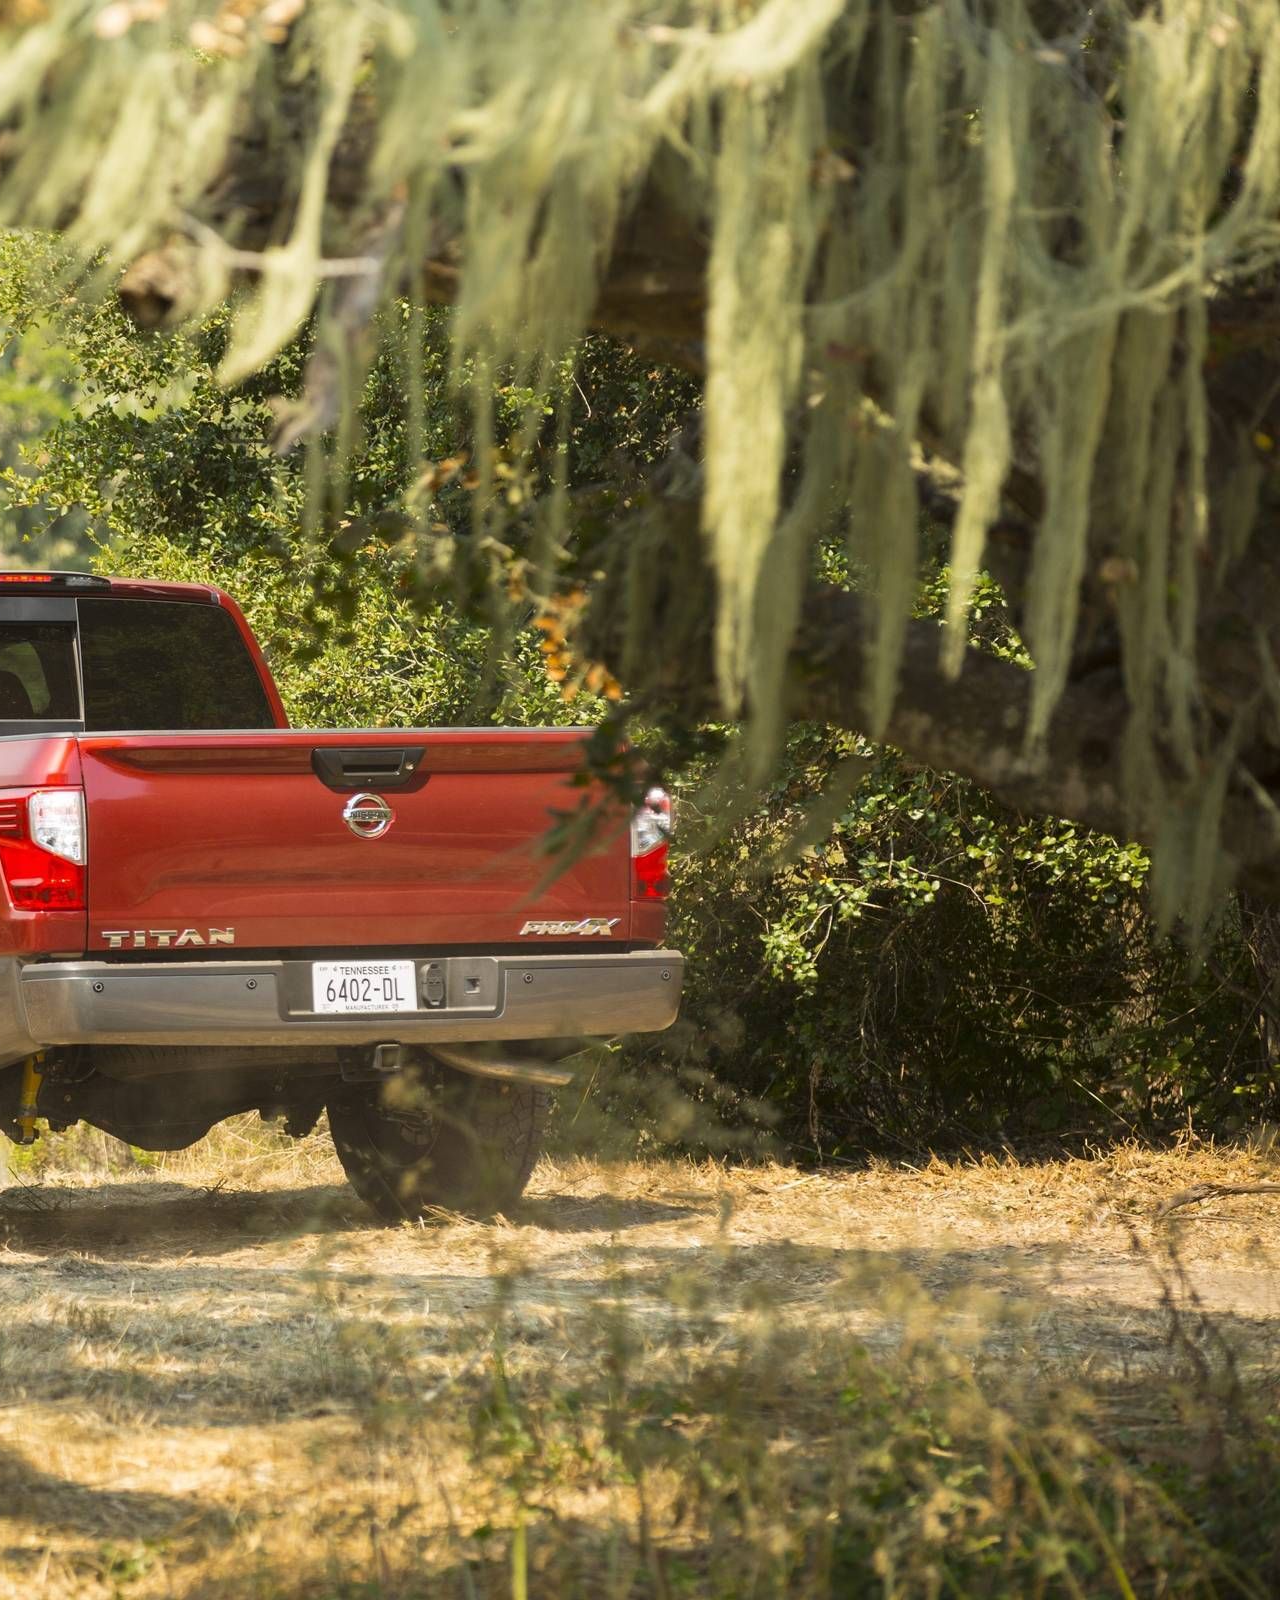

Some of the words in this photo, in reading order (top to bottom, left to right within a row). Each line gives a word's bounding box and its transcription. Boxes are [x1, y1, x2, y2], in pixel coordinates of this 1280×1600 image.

[101, 928, 235, 948] TITAN
[340, 966, 390, 975] TENNESSEE
[326, 978, 405, 1002] 6402-DL
